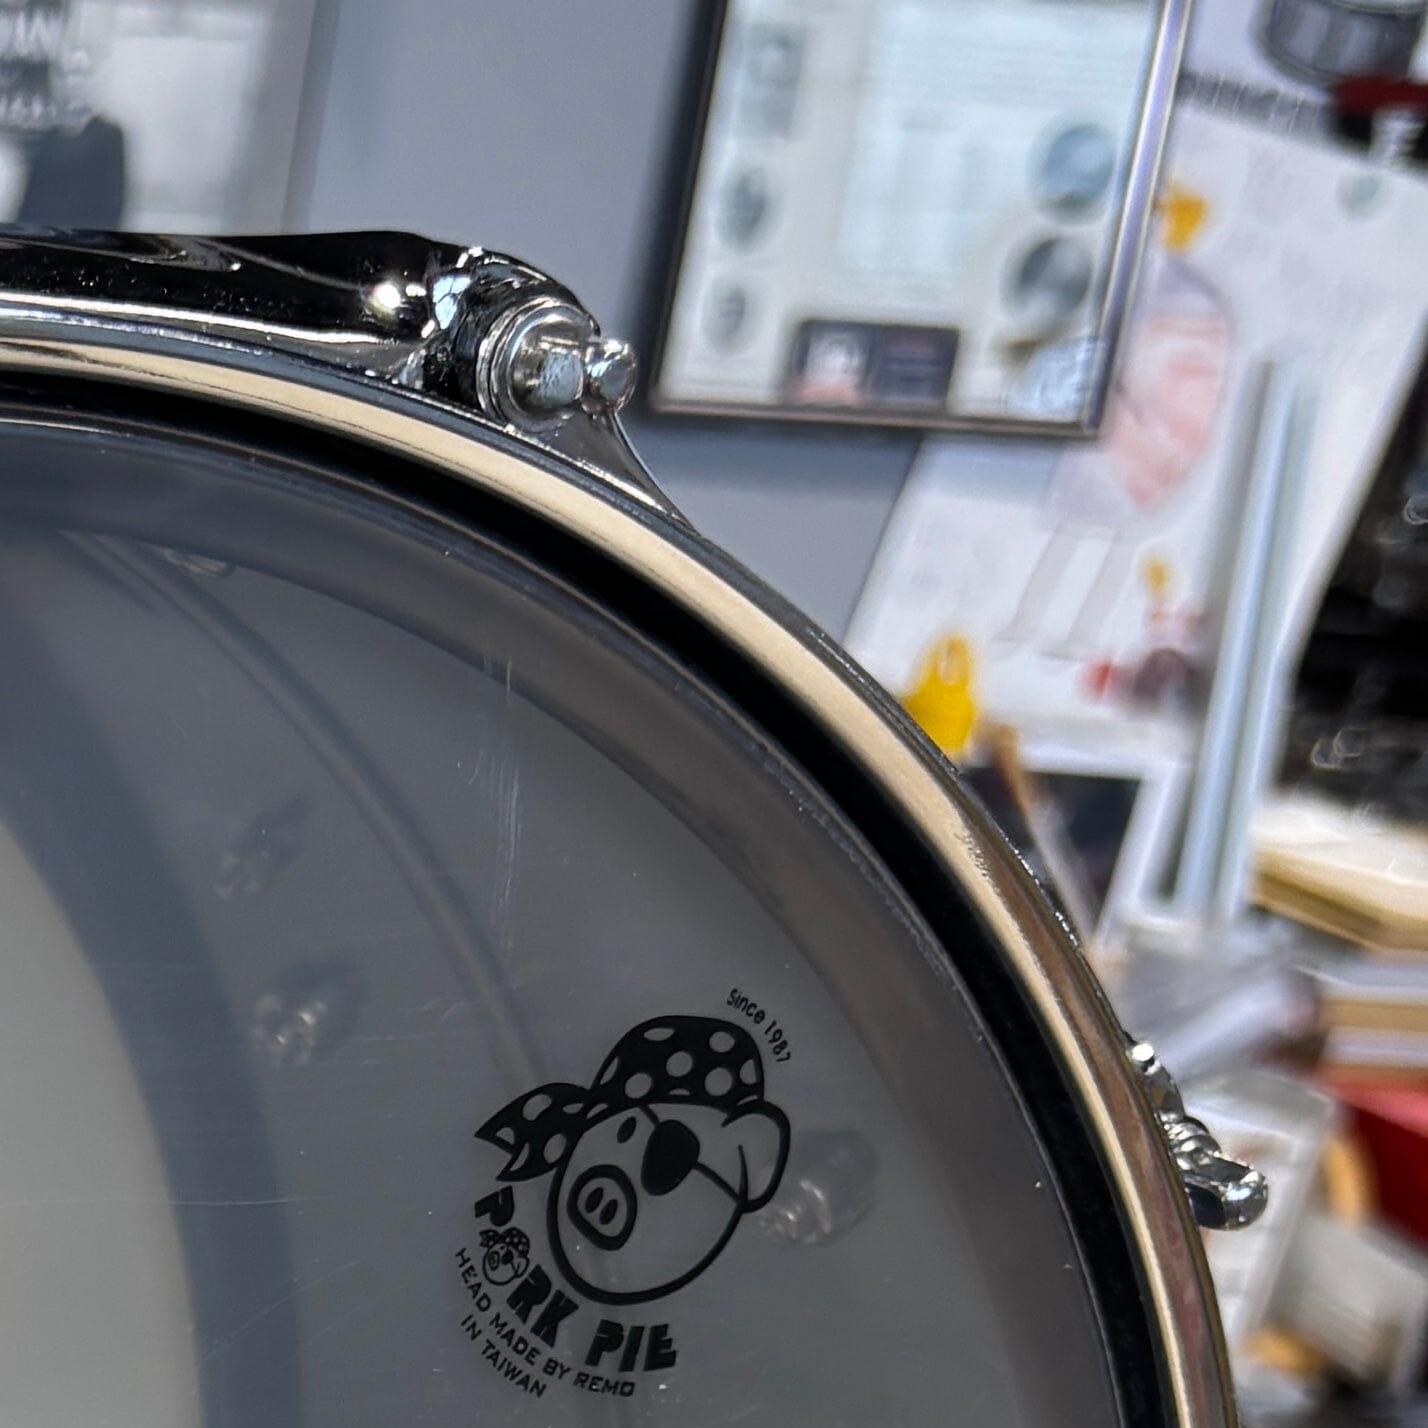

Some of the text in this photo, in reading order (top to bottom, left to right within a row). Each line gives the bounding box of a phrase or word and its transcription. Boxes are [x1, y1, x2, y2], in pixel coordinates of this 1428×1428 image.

[455, 1247, 636, 1397] HEAD MADE BY REMO
[460, 1314, 547, 1398] IN TAIWAN
[584, 1319, 679, 1372] PIE
